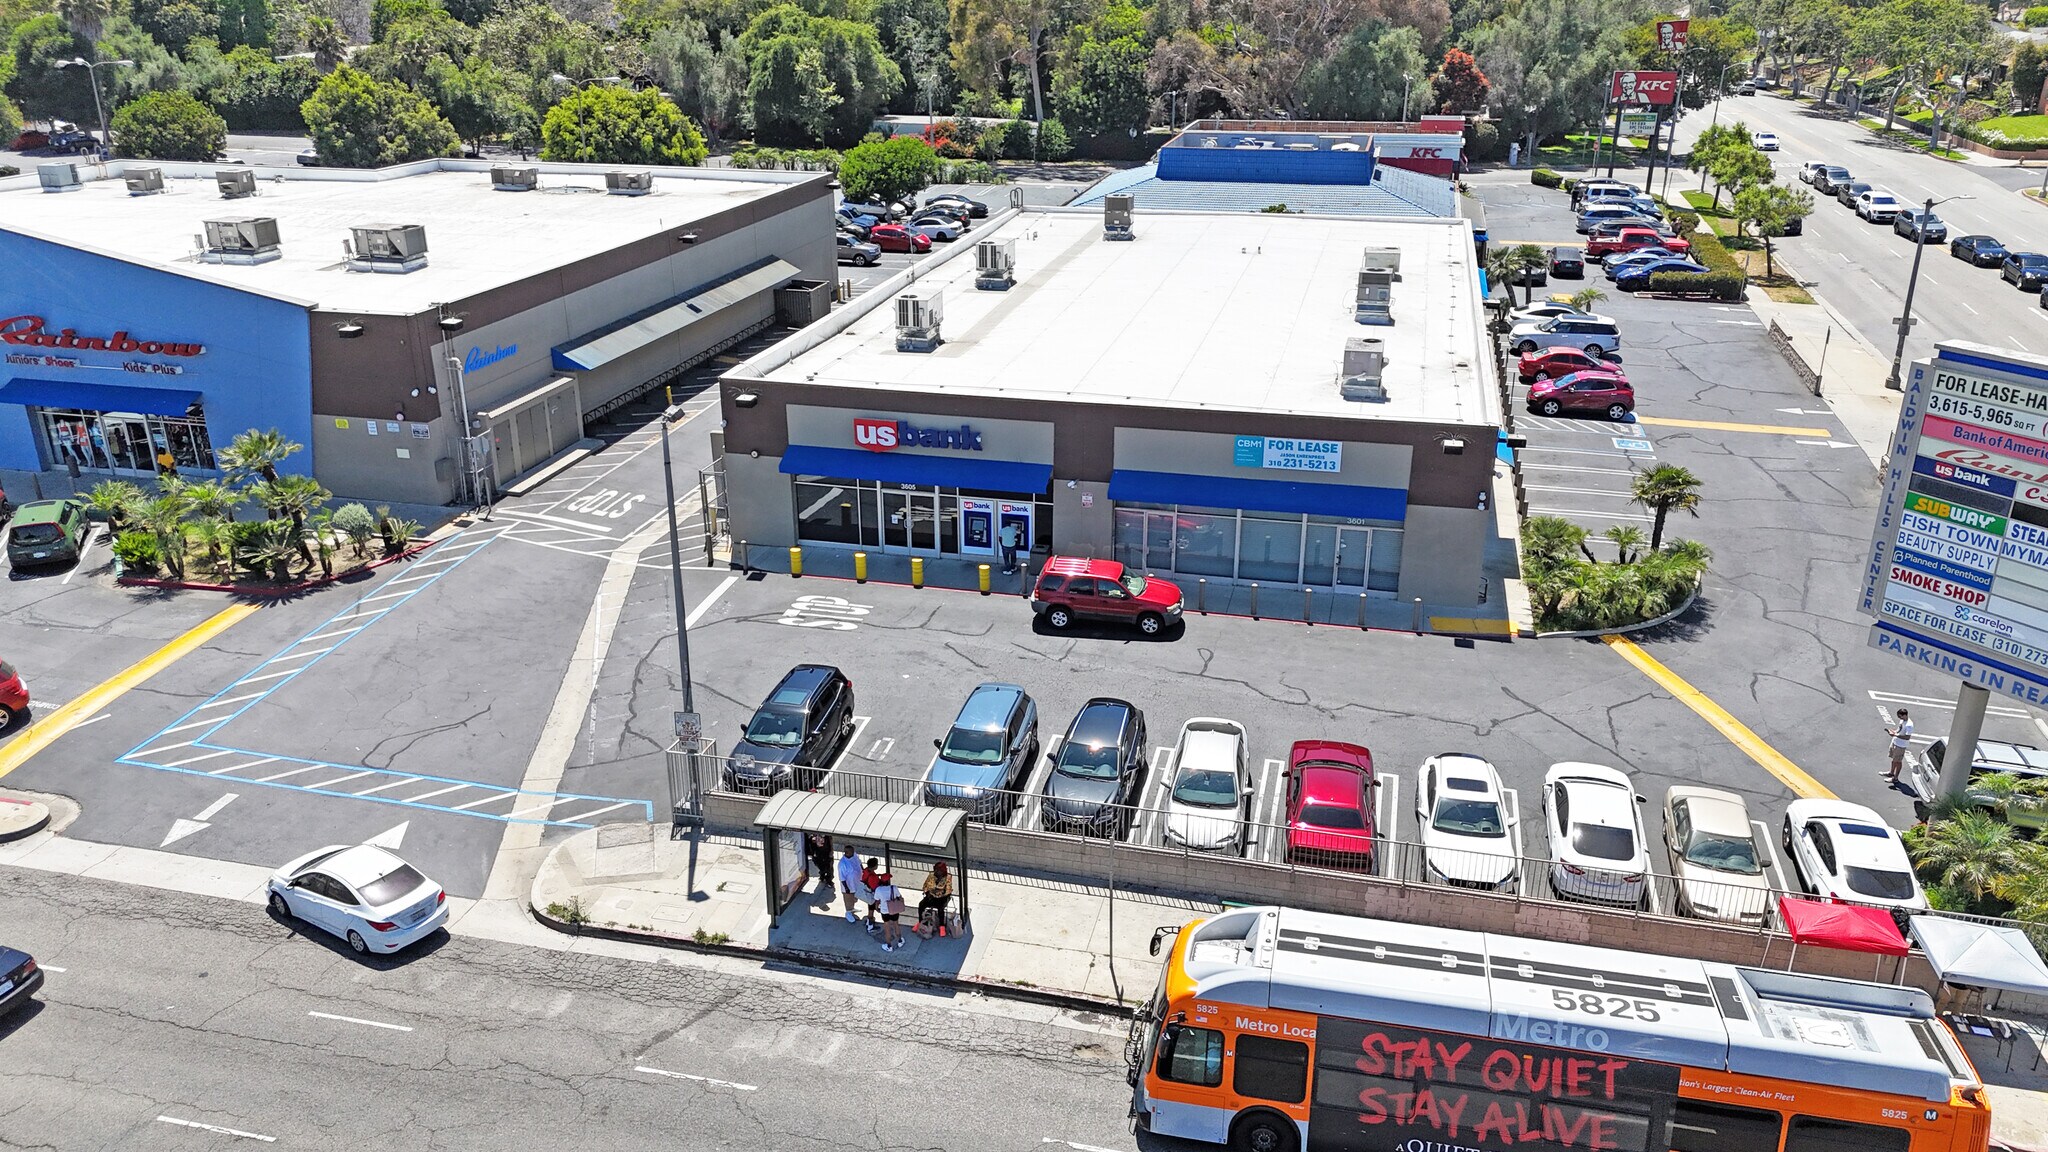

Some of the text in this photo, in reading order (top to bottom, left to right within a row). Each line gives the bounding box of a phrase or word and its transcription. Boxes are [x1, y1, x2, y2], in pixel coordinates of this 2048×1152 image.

[1638, 80, 1671, 90] KFC
[1410, 148, 1442, 158] KFC
[0, 315, 204, 357] Rainbow
[45, 356, 76, 368] Shoes
[152, 364, 176, 375] Plus
[464, 344, 518, 375] Rainbow
[1936, 374, 1967, 394] FOR
[1930, 396, 2013, 426] 3,615-5,965
[2014, 420, 2024, 430] SQ
[2026, 423, 2036, 431] FT
[856, 420, 982, 451] us bank
[1268, 440, 1338, 454] FOR LEASE
[1954, 426, 1986, 444] Bank
[1988, 436, 2003, 448] of
[1283, 458, 1336, 470] 231-5213
[567, 488, 646, 518] STOP
[1863, 369, 1924, 610] BALDWIN HILLS CENTER
[974, 502, 990, 510] bank
[1914, 498, 1996, 528] SUBWAY
[1902, 514, 2000, 552] FISH TOWN
[2011, 524, 2048, 547] STEA
[1898, 532, 1994, 570] BEAUTY SUPPLY
[1904, 551, 1990, 586] Planned Parenthood
[1890, 568, 1986, 606] SMOKE SHOP
[777, 595, 874, 631] STOP
[1972, 614, 2013, 634] carelon
[1884, 602, 1921, 622] SPACE
[1924, 616, 1946, 631] FOR
[1950, 622, 1987, 644] LEASE
[1992, 637, 2022, 658] (310)
[1878, 633, 1974, 678] PARKING
[1980, 670, 2004, 690] IN
[1196, 1004, 1218, 1014] 5825
[1550, 988, 1661, 1023] 5825
[1236, 1016, 1317, 1039] Metro Loca
[1494, 1008, 1610, 1050] Metro
[1356, 1032, 1629, 1100] STAY QUIET
[1702, 1082, 1732, 1094] Largest
[1734, 1086, 1772, 1099] Clean-Air
[1774, 1092, 1795, 1102] Fleet
[1358, 1087, 1618, 1151] STAY ALIVE
[1882, 1108, 1908, 1120] 5825
[1925, 1110, 1937, 1120] M
[1396, 1144, 1404, 1152] A
